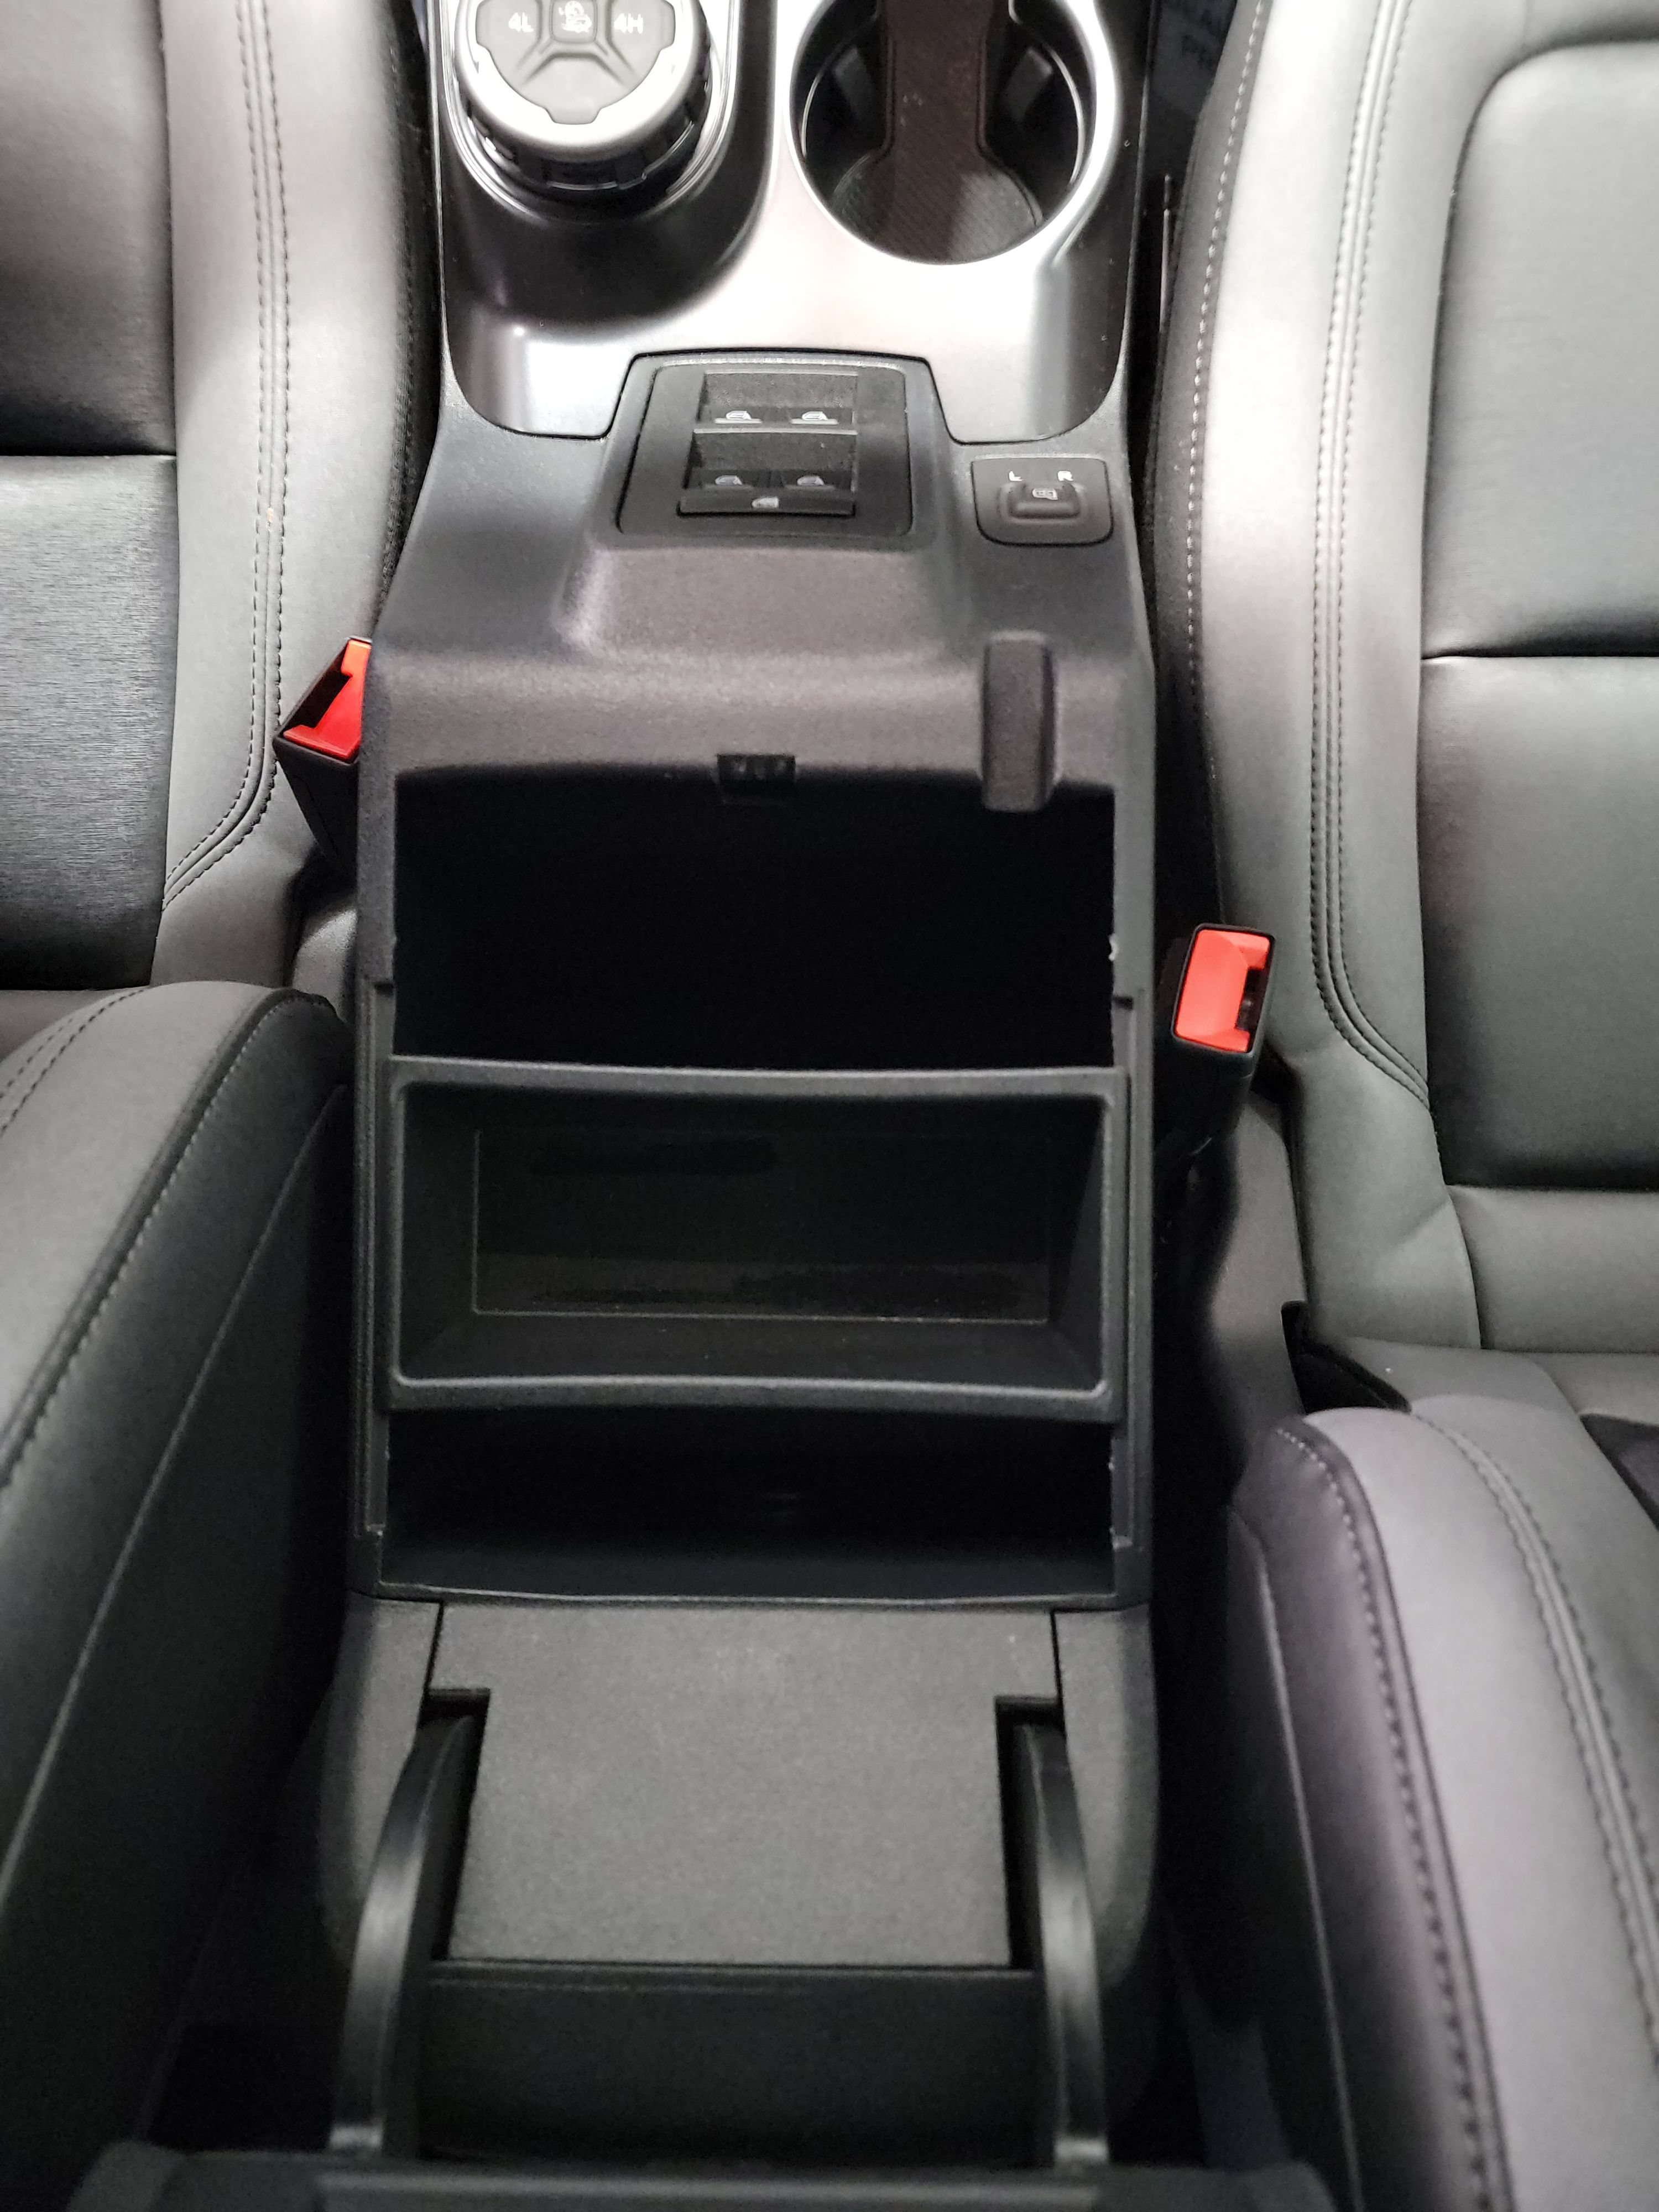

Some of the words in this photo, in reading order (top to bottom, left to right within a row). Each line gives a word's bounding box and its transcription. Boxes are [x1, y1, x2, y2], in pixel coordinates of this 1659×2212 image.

[508, 12, 534, 33] 4L
[614, 13, 644, 34] 4H
[1009, 471, 1022, 481] L
[1057, 470, 1074, 481] R
